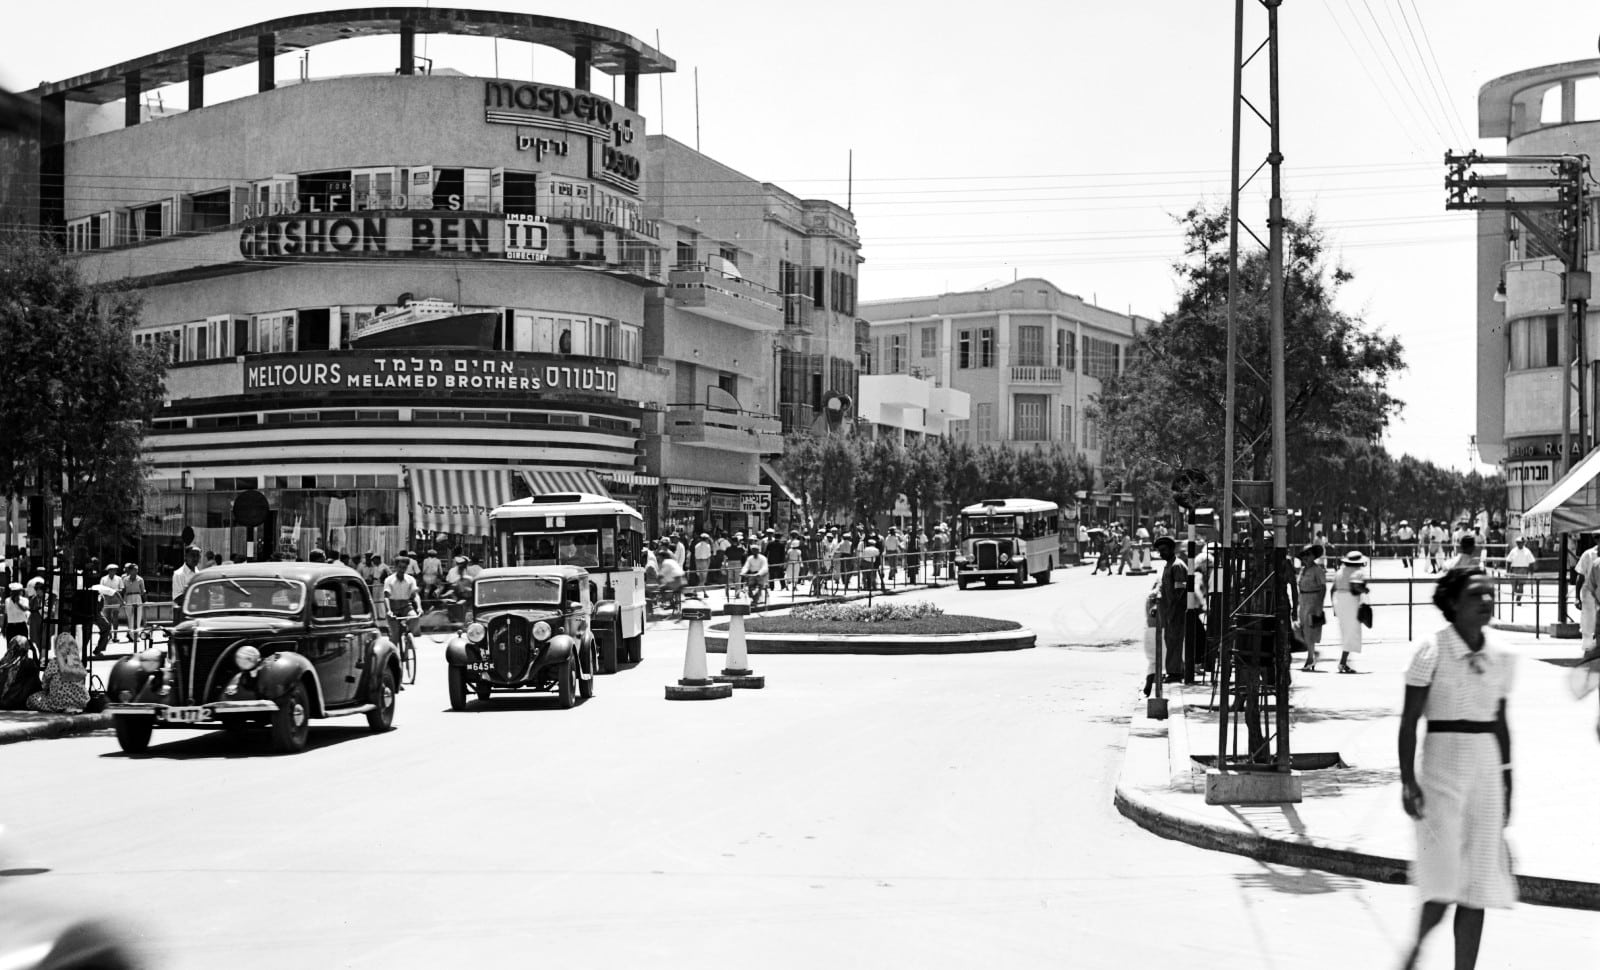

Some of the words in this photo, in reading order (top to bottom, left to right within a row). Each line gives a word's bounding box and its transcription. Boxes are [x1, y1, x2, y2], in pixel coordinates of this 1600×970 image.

[485, 81, 612, 124] maspero
[506, 213, 548, 223] IMPORT
[239, 217, 387, 257] GERSHON
[411, 217, 489, 253] BEN
[507, 223, 548, 251] ID
[506, 251, 548, 262] DIRECTORY
[374, 357, 443, 372] מלמד
[454, 359, 514, 374] אחים
[248, 363, 341, 388] MELTOURS
[347, 374, 438, 388] MELAMED
[445, 375, 541, 390] BROTHERS
[546, 366, 617, 392] מלטורס
[760, 494, 770, 510] 5
